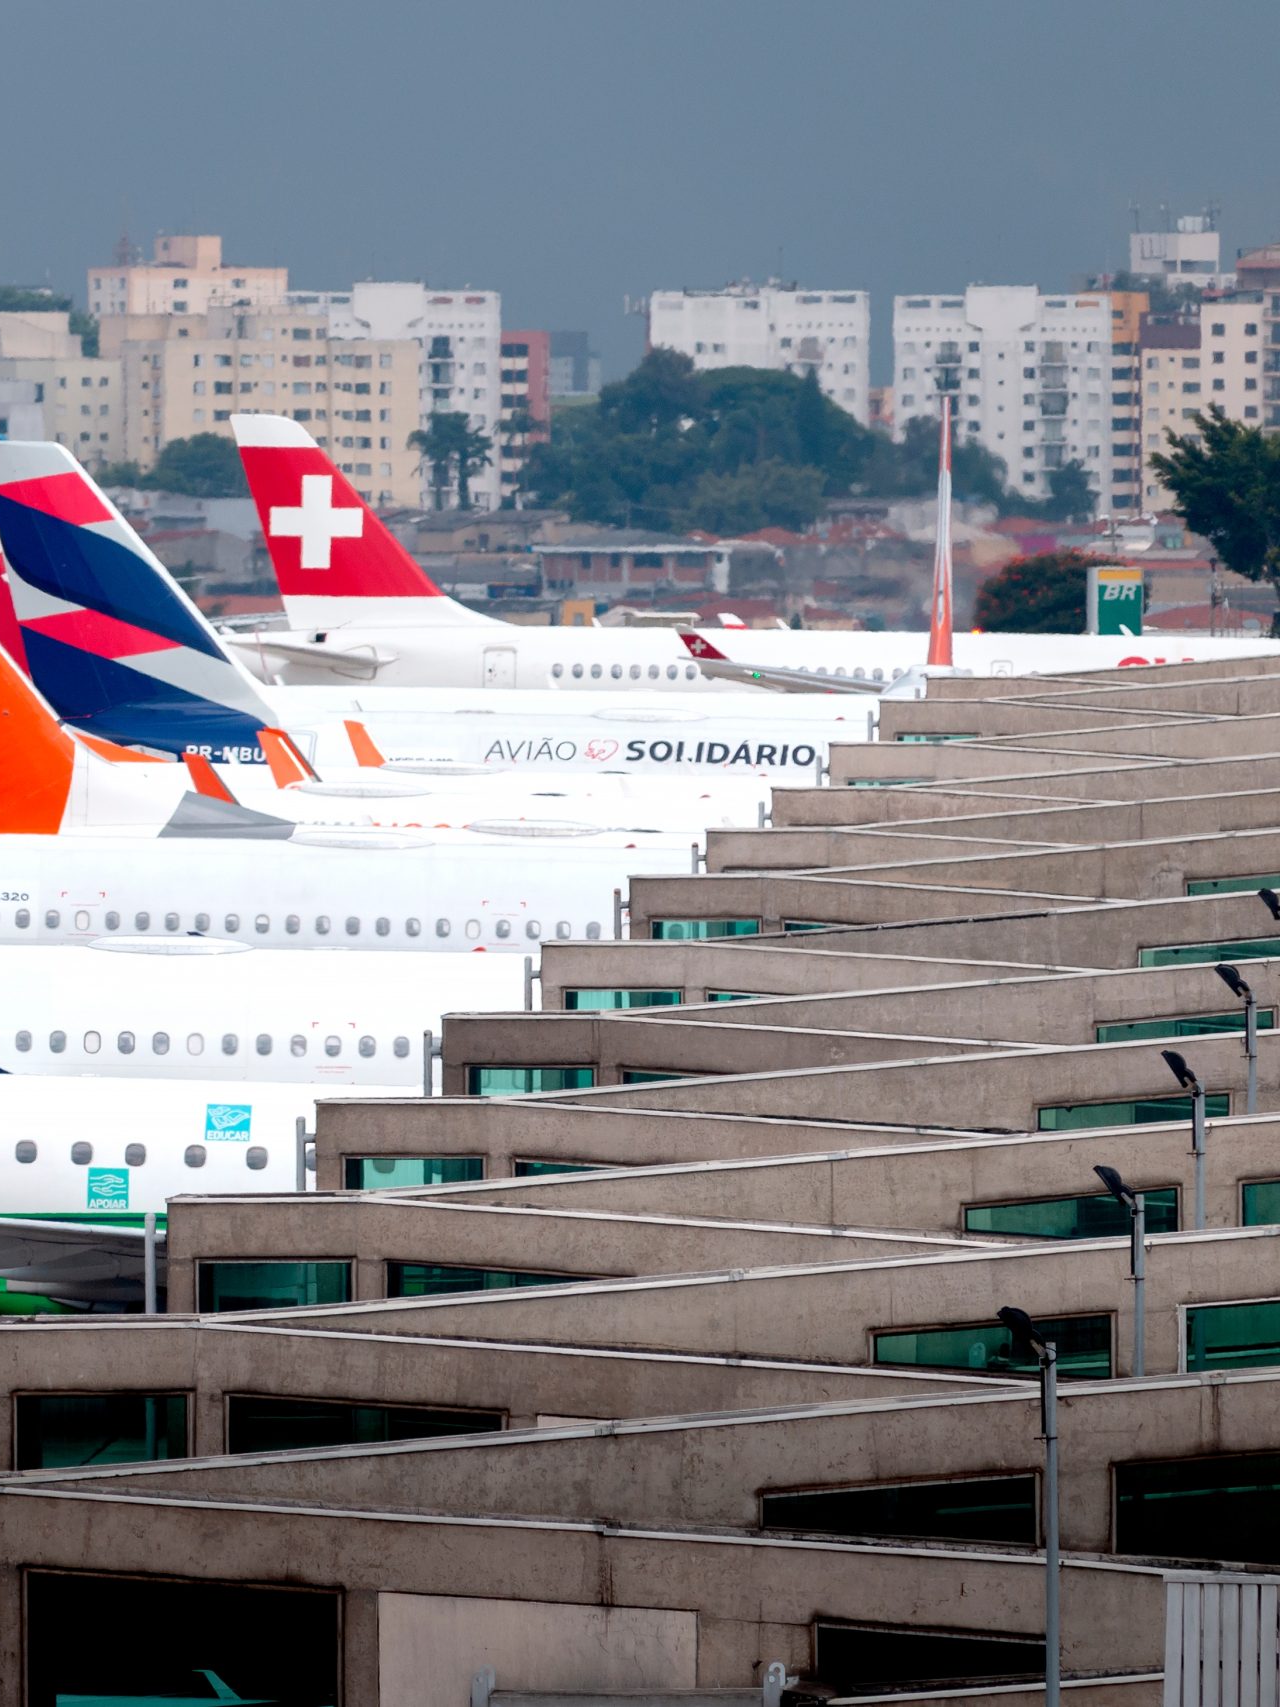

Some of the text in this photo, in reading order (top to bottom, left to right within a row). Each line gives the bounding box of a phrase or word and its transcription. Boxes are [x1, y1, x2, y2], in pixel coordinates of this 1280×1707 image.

[1103, 583, 1137, 601] BR
[484, 737, 816, 767] AVIÃO SOLIDÁRIO
[207, 1130, 250, 1141] EDUCAR
[89, 1199, 127, 1209] APOIAR
